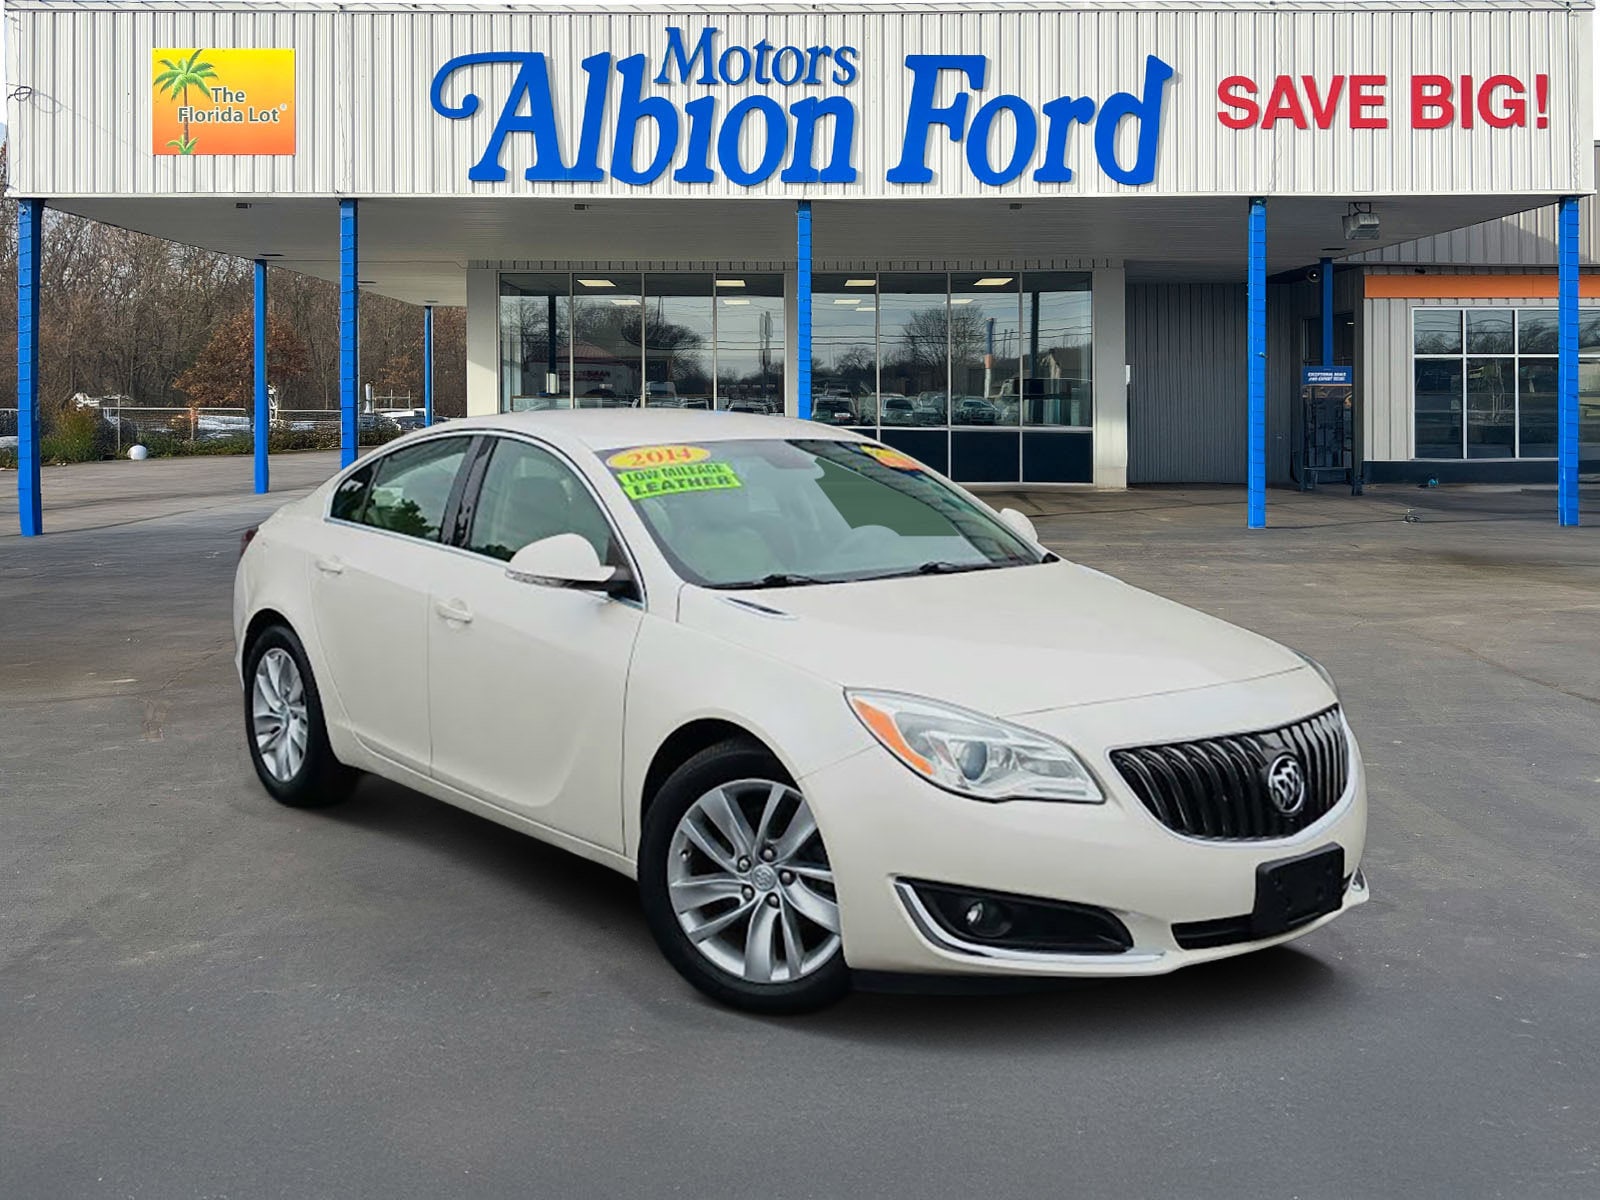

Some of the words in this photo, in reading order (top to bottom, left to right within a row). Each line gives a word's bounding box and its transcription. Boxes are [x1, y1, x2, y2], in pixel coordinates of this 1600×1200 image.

[653, 27, 857, 86] Motors
[210, 86, 245, 103] The
[1217, 75, 1388, 129] SAVE
[1411, 74, 1548, 129] BIG!
[177, 106, 243, 122] Florida
[430, 52, 857, 186] Albion
[886, 54, 1175, 186] Ford
[627, 448, 691, 466] 2014
[626, 469, 659, 483] LOW
[661, 463, 724, 478] MILEAGE
[633, 475, 731, 496] LEATHER
